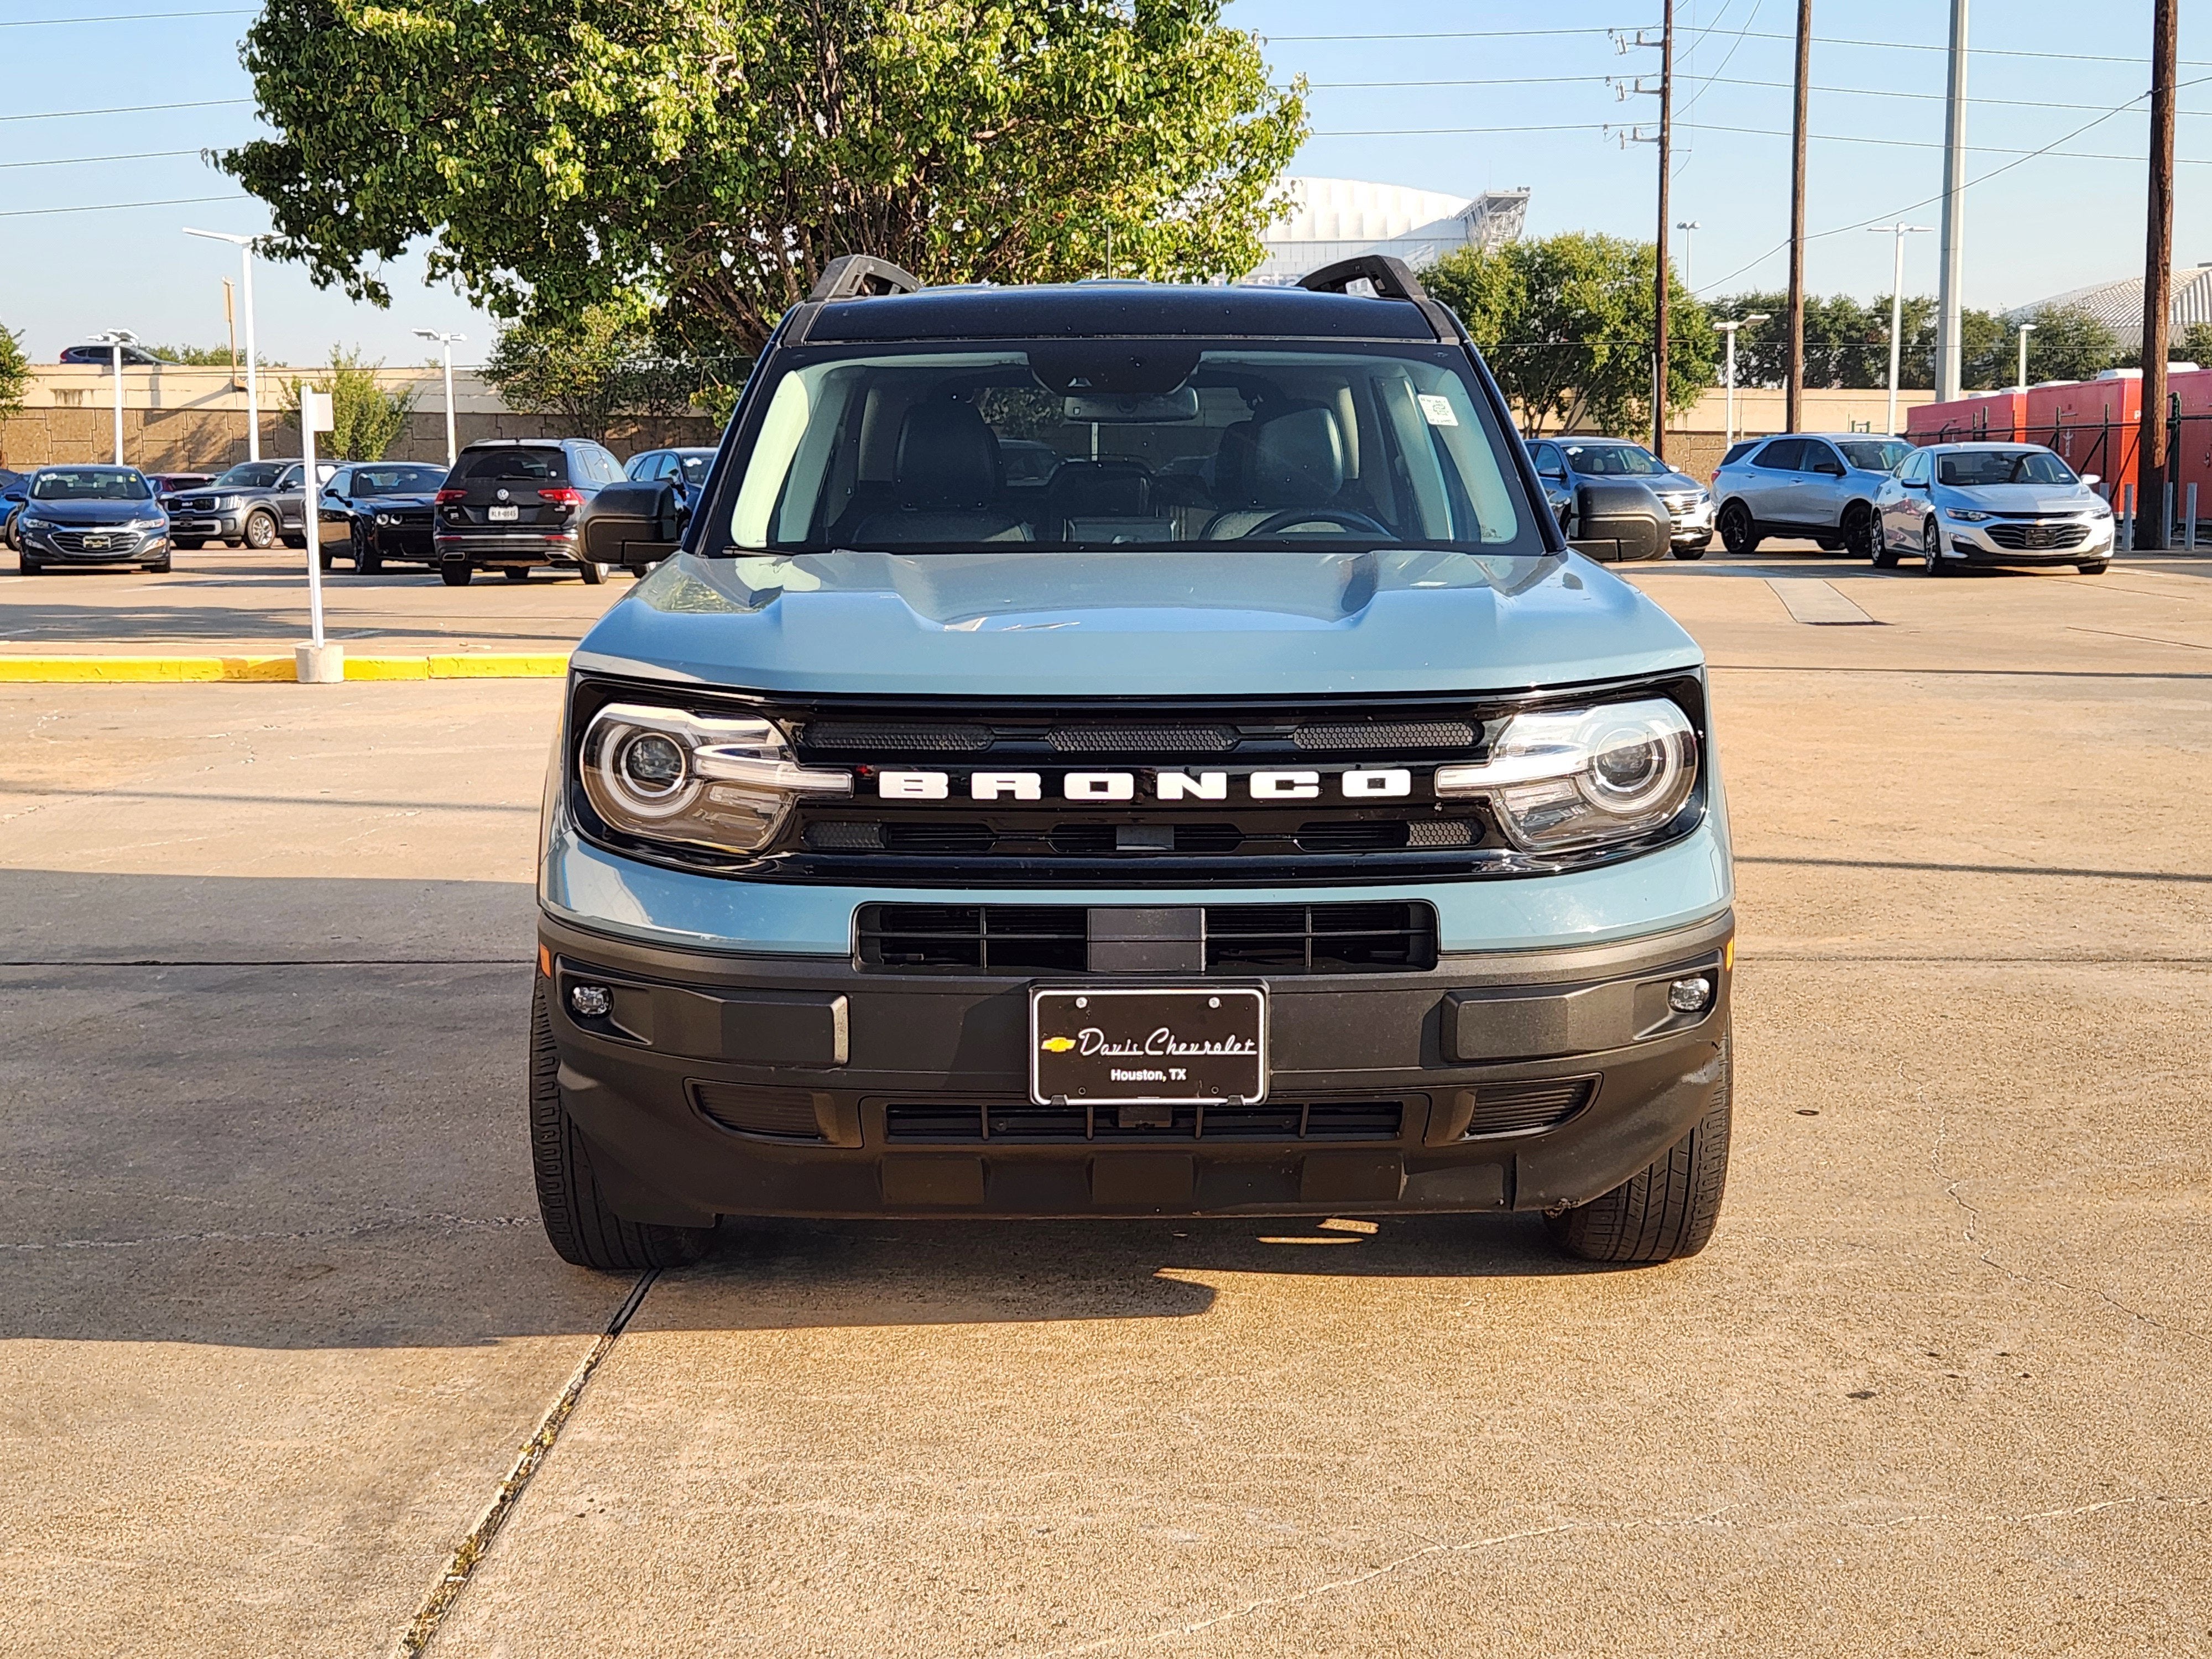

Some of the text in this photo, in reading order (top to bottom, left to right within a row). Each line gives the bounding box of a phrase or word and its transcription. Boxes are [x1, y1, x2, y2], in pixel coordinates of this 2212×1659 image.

[879, 770, 1410, 799] BRONCO
[1078, 1028, 1257, 1055] Davis Chevrolet
[1111, 1069, 1186, 1082] Houston, TX
